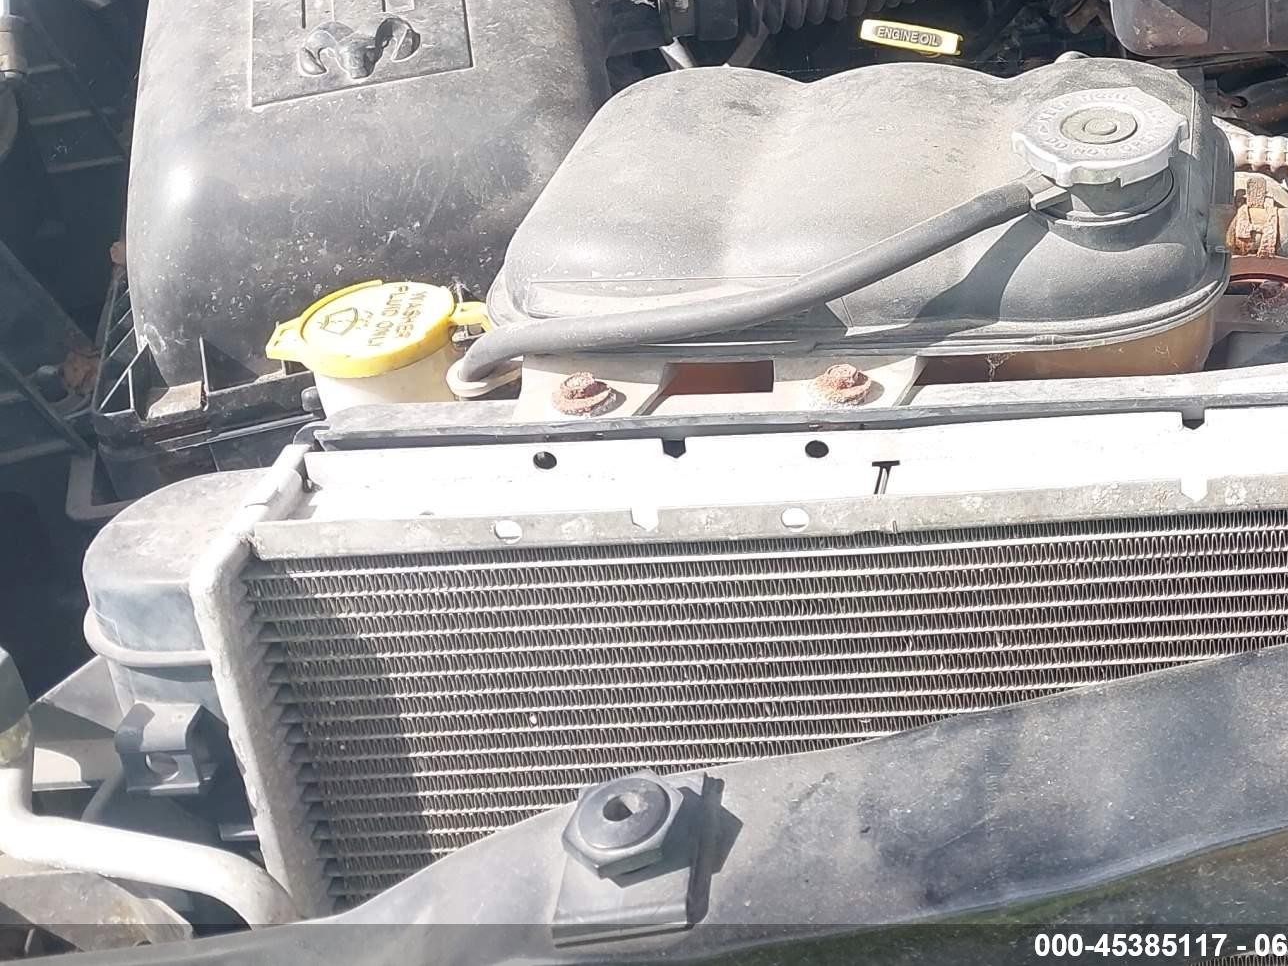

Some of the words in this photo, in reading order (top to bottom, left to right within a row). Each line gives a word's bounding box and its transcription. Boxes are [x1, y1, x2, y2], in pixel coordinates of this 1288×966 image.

[877, 26, 919, 43] ENGINE
[919, 34, 940, 47] OIL
[381, 285, 409, 316] FLUID
[395, 290, 427, 338] WASHER
